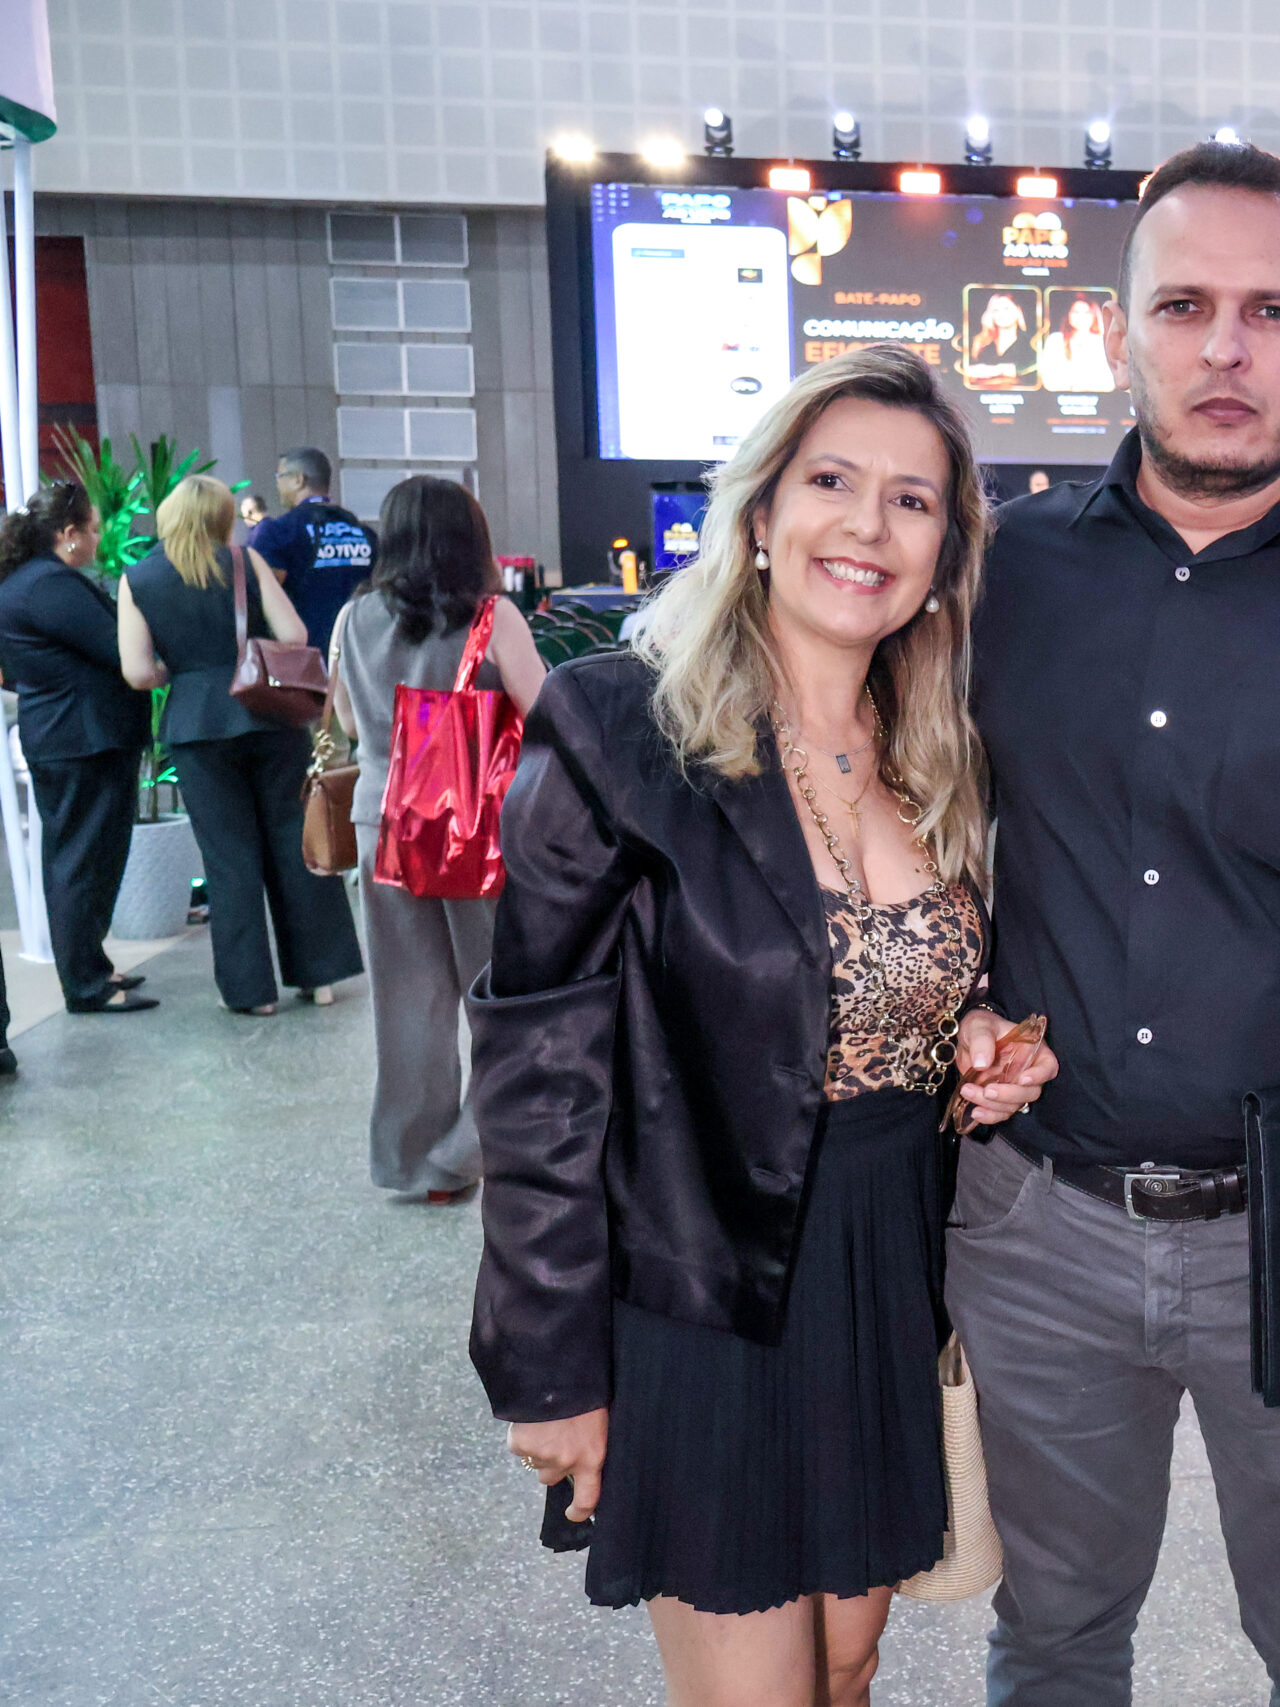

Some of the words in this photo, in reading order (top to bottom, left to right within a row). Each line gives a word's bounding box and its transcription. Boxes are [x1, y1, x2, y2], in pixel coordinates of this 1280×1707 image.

[1002, 226, 1068, 245] PAPO
[834, 291, 921, 306] BATE-PAPO
[803, 318, 955, 342] COMUNICAÇÃO
